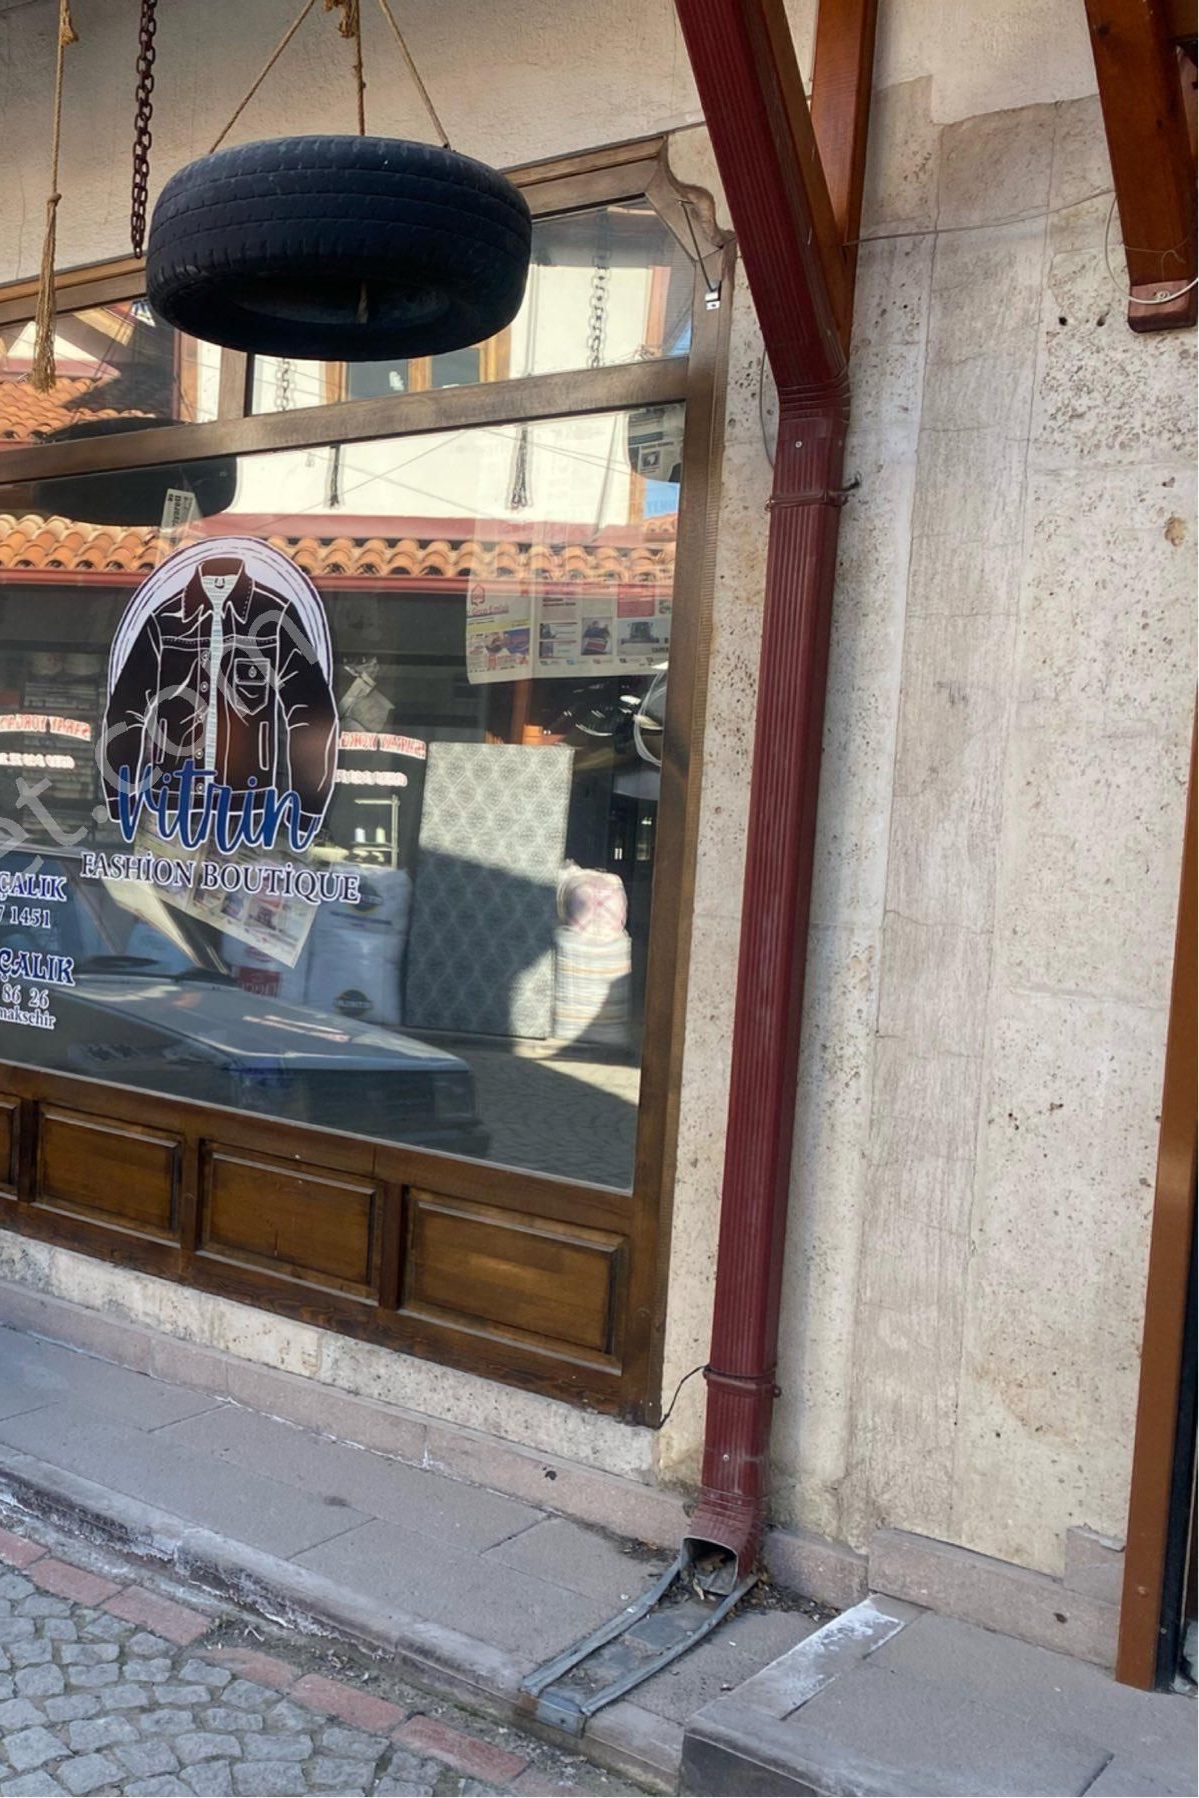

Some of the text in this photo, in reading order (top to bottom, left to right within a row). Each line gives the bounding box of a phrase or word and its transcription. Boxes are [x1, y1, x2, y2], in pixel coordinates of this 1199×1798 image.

[9, 906, 51, 928] 1451
[2, 983, 21, 1004] 86
[28, 987, 50, 1009] 26
